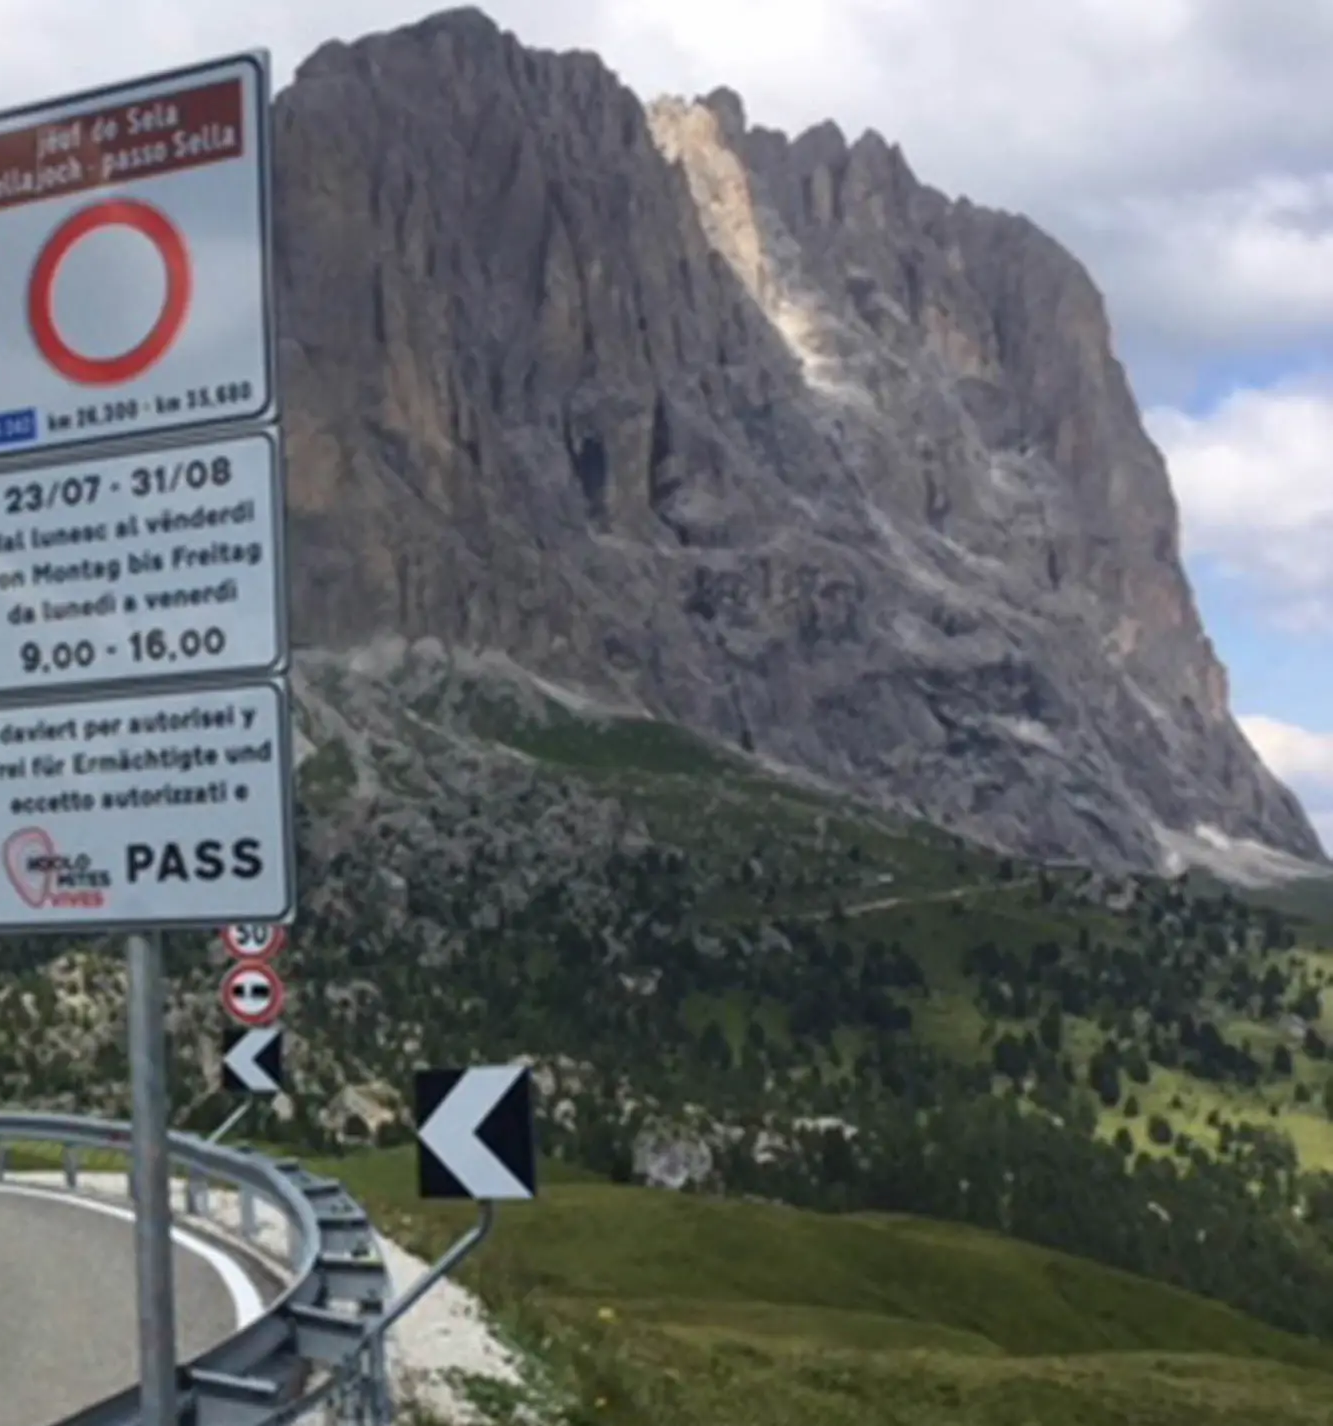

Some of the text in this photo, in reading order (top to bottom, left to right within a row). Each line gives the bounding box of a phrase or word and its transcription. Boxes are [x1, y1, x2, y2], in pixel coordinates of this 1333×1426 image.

[102, 145, 168, 180] passo
[172, 125, 235, 158] Sella
[4, 474, 102, 514] 23/07
[130, 456, 232, 497] 31/08
[30, 522, 108, 550] lunesc
[114, 515, 139, 537] al
[30, 559, 122, 586] Montag
[127, 551, 165, 575] bis
[171, 541, 264, 571] Freitag
[7, 606, 37, 626] da
[122, 598, 139, 613] a
[83, 716, 123, 741] per
[128, 704, 236, 734] autorisei
[240, 708, 256, 729] y
[31, 752, 66, 776] für
[71, 745, 219, 775] Ermächtigte
[224, 739, 273, 765] und
[10, 780, 249, 816] eccetto autorizzati e
[124, 836, 265, 884] PASS
[235, 921, 268, 946] 50
